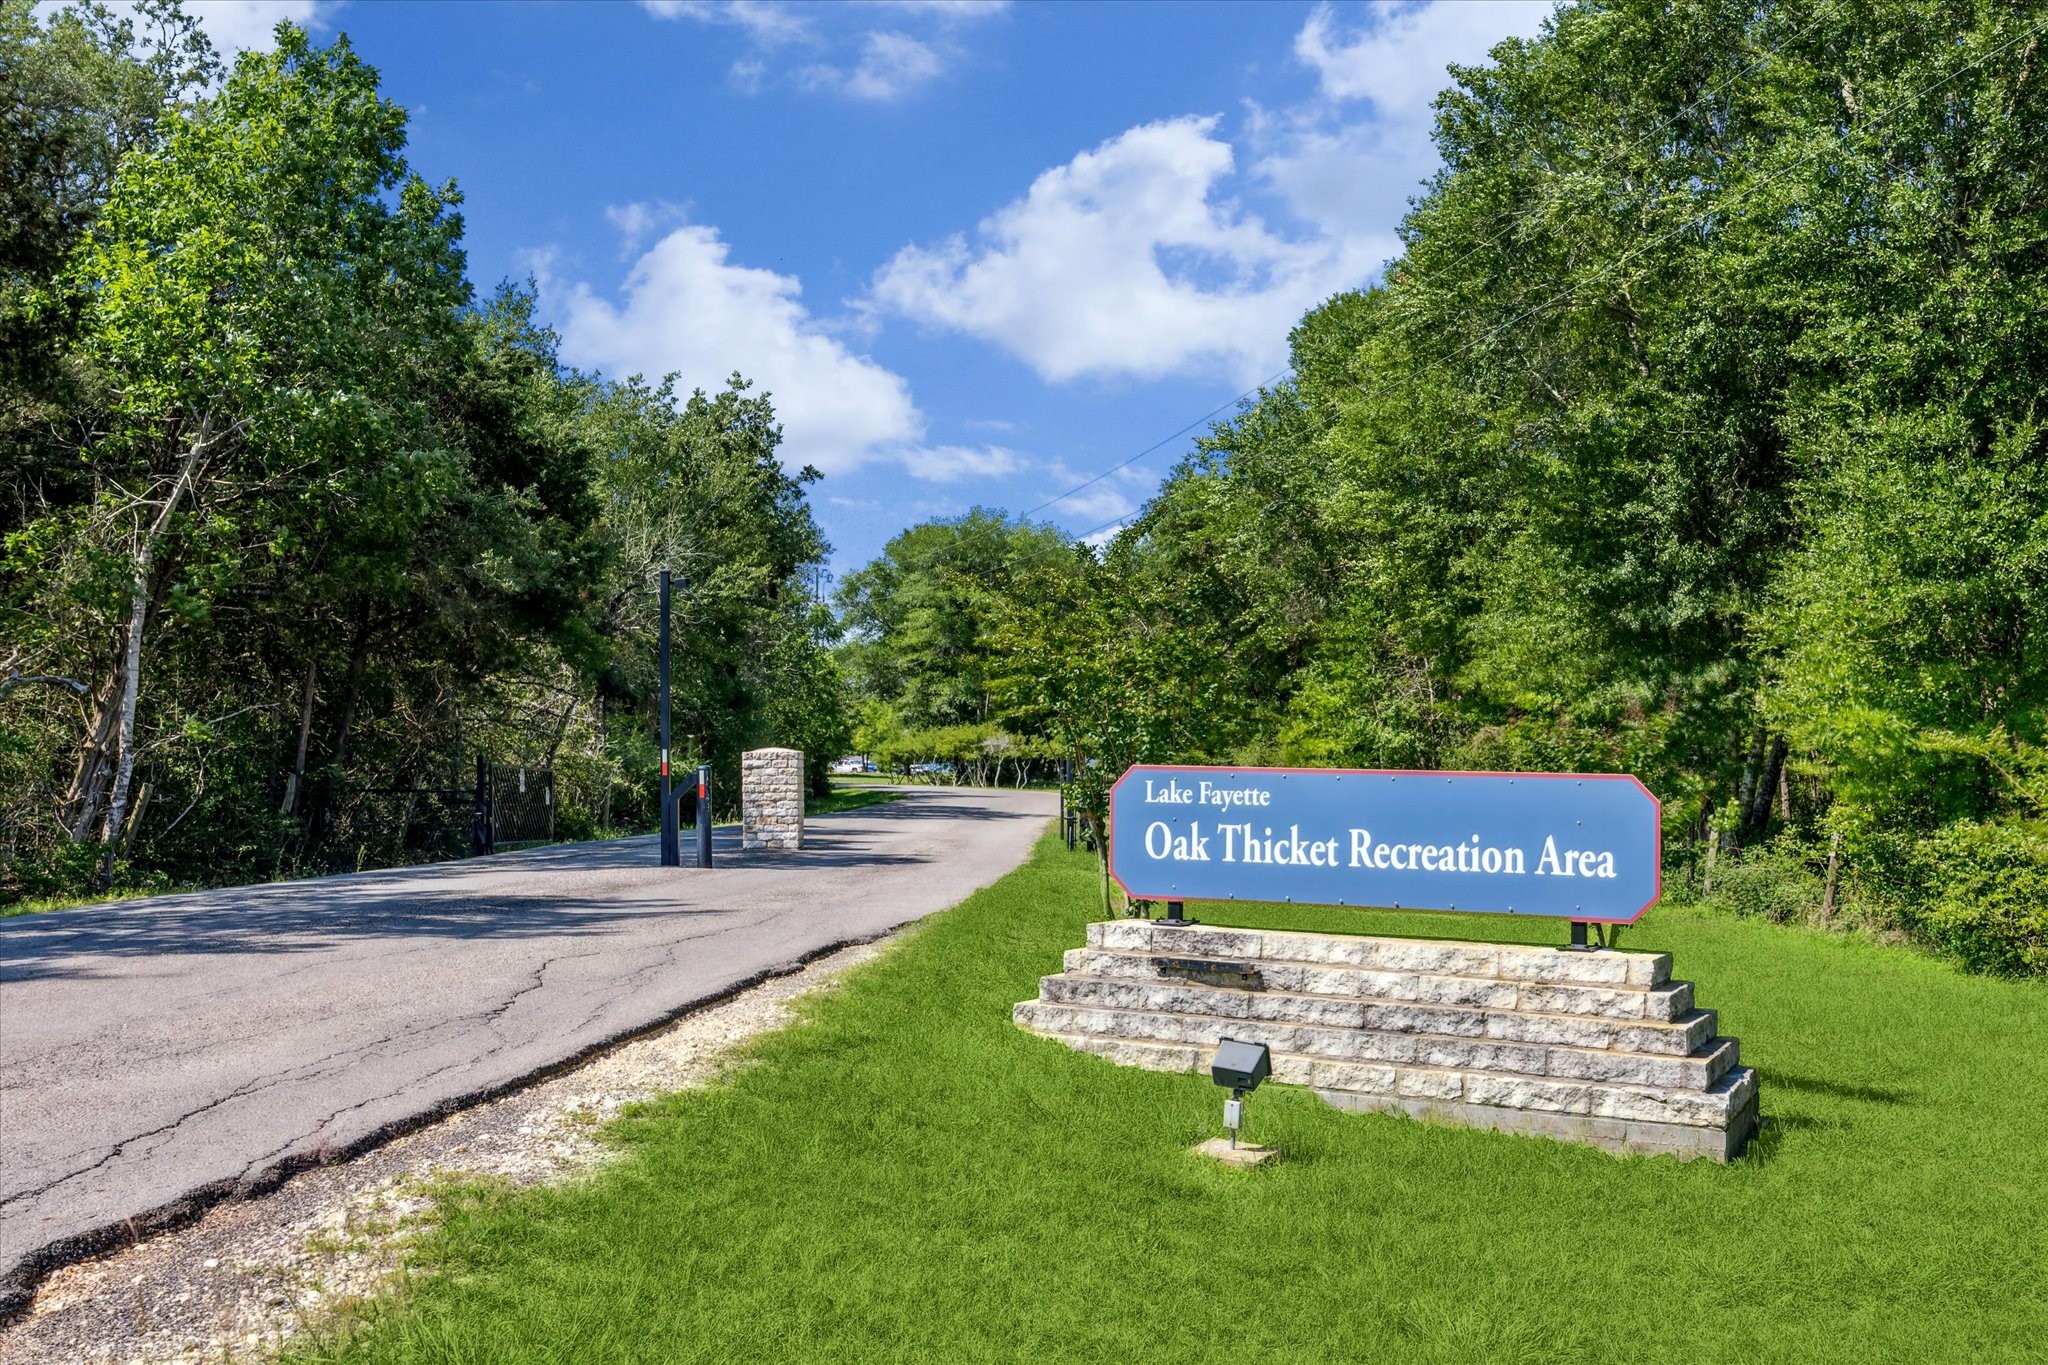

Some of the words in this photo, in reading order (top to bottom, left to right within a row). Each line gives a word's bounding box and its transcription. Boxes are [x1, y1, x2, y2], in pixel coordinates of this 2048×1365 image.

[1144, 780, 1193, 804] Lake
[1198, 781, 1271, 813] Fayette
[1144, 820, 1211, 861] Oak
[1217, 822, 1339, 867] Thicket
[1348, 828, 1526, 874] Recreation
[1534, 834, 1617, 879] Area
